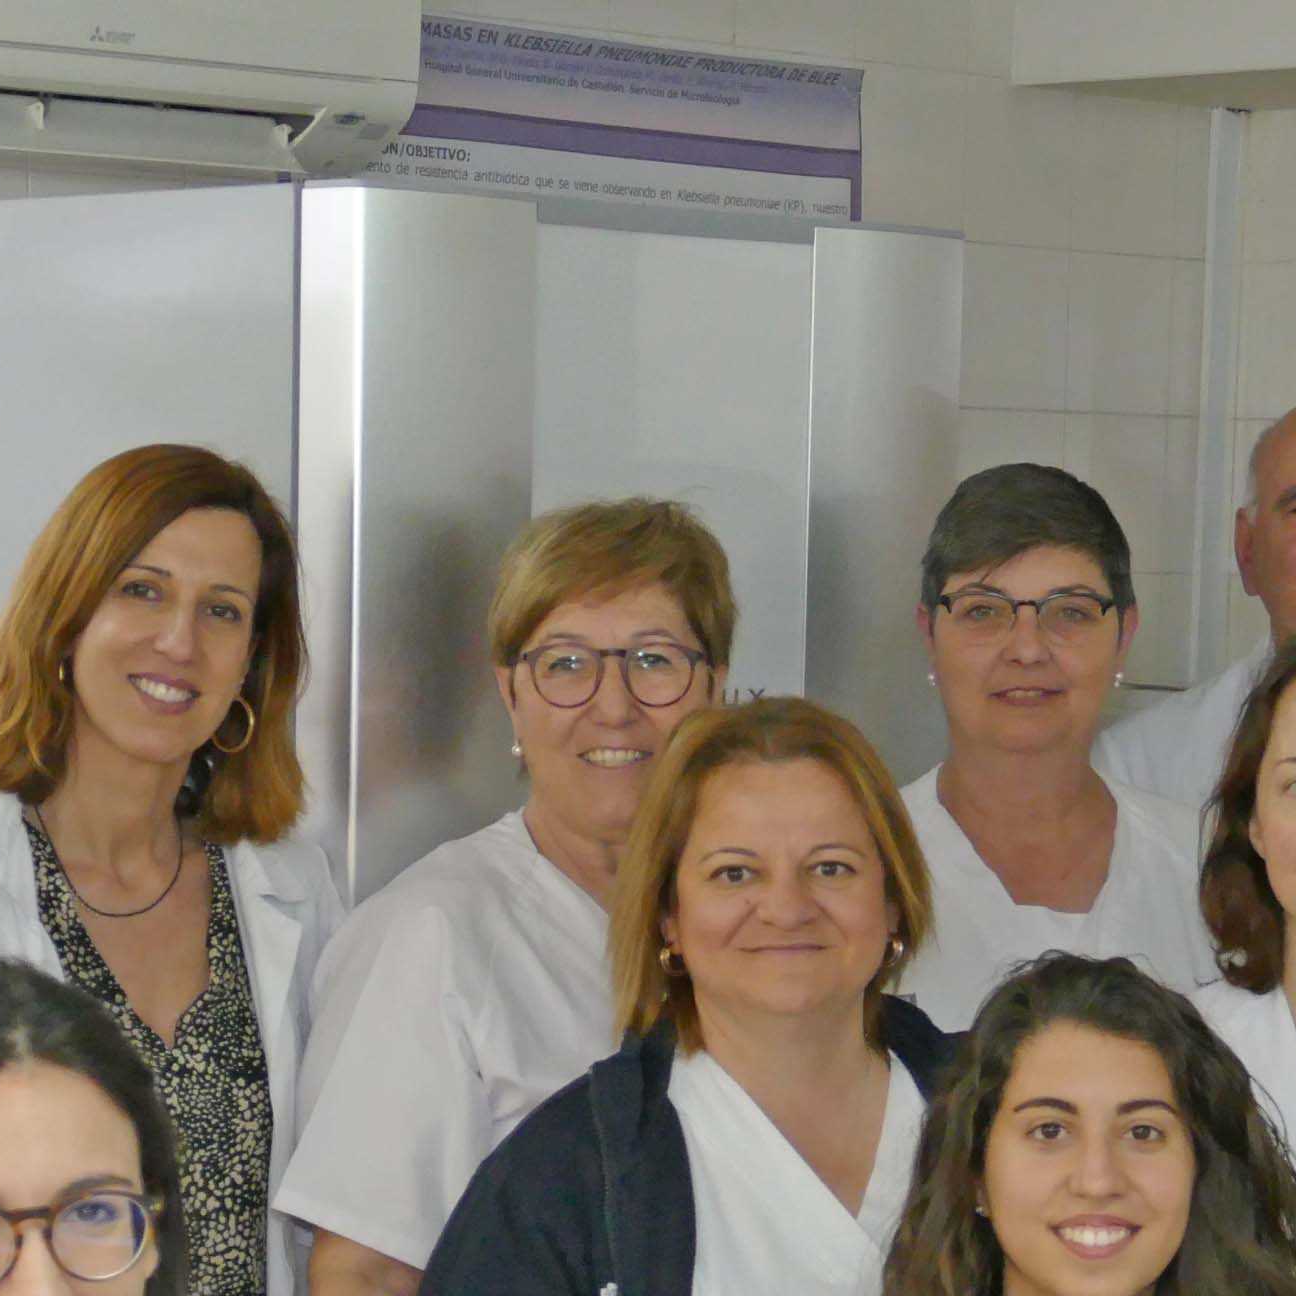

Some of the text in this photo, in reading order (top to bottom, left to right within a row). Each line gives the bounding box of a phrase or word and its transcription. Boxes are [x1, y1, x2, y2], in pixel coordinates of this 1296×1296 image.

[421, 21, 472, 42] MASAS
[477, 28, 499, 46] EN
[503, 32, 591, 58] KLEBSIELLA
[594, 45, 692, 69] PNEUMONIAE
[695, 58, 786, 80] PRODUCTORA
[787, 68, 806, 83] DE
[807, 71, 842, 86] BLEE
[396, 161, 409, 175] de
[415, 165, 468, 181] resistencia
[535, 177, 554, 190] que
[559, 178, 569, 190] se
